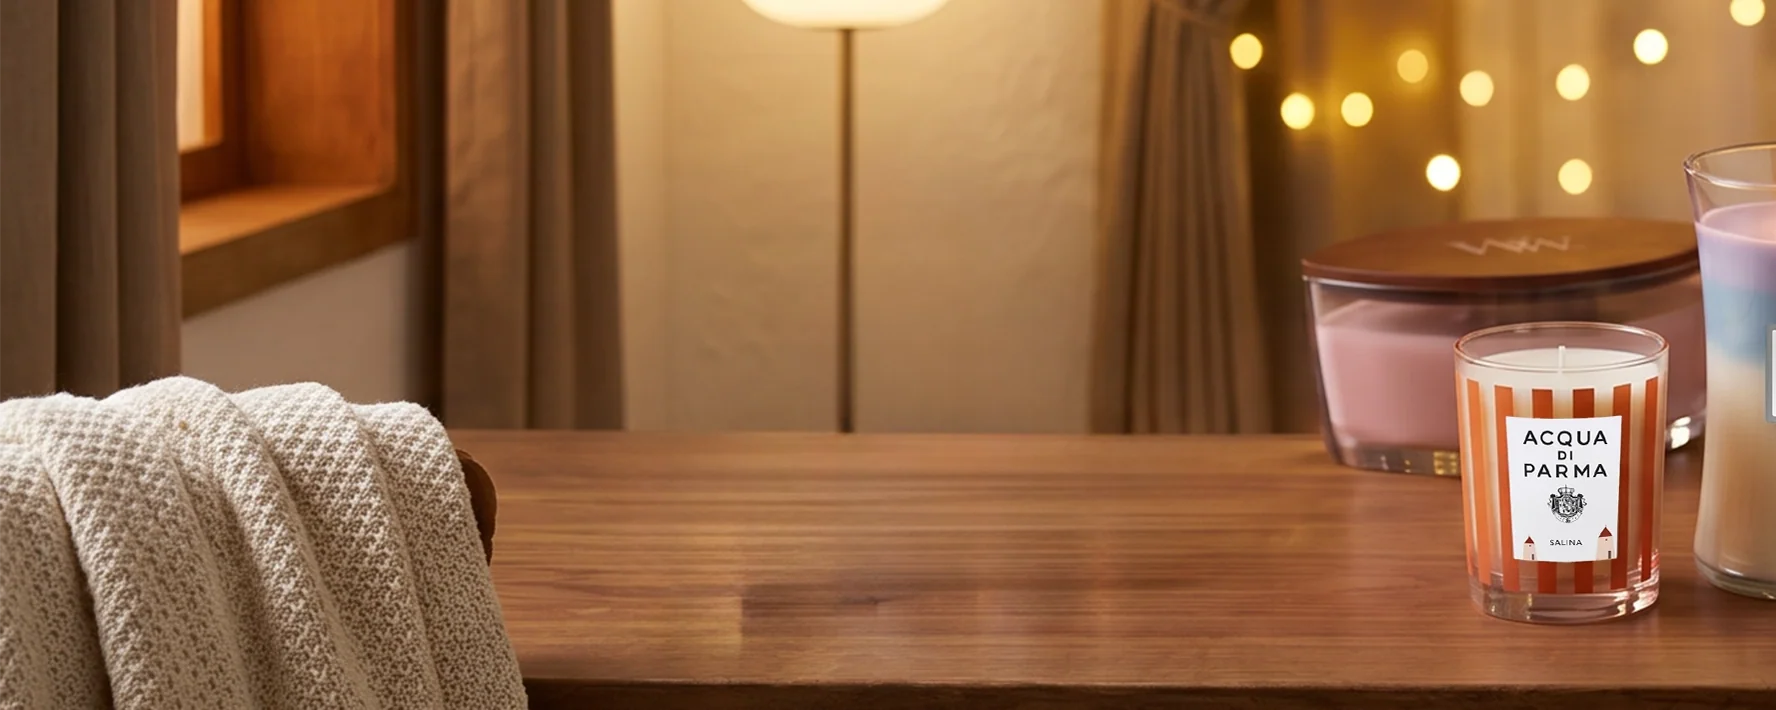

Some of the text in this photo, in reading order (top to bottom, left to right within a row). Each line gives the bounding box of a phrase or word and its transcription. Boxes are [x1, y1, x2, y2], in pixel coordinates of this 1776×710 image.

[1523, 430, 1608, 447] ACQUA
[1557, 450, 1573, 460] DI
[1524, 463, 1608, 478] PARMA
